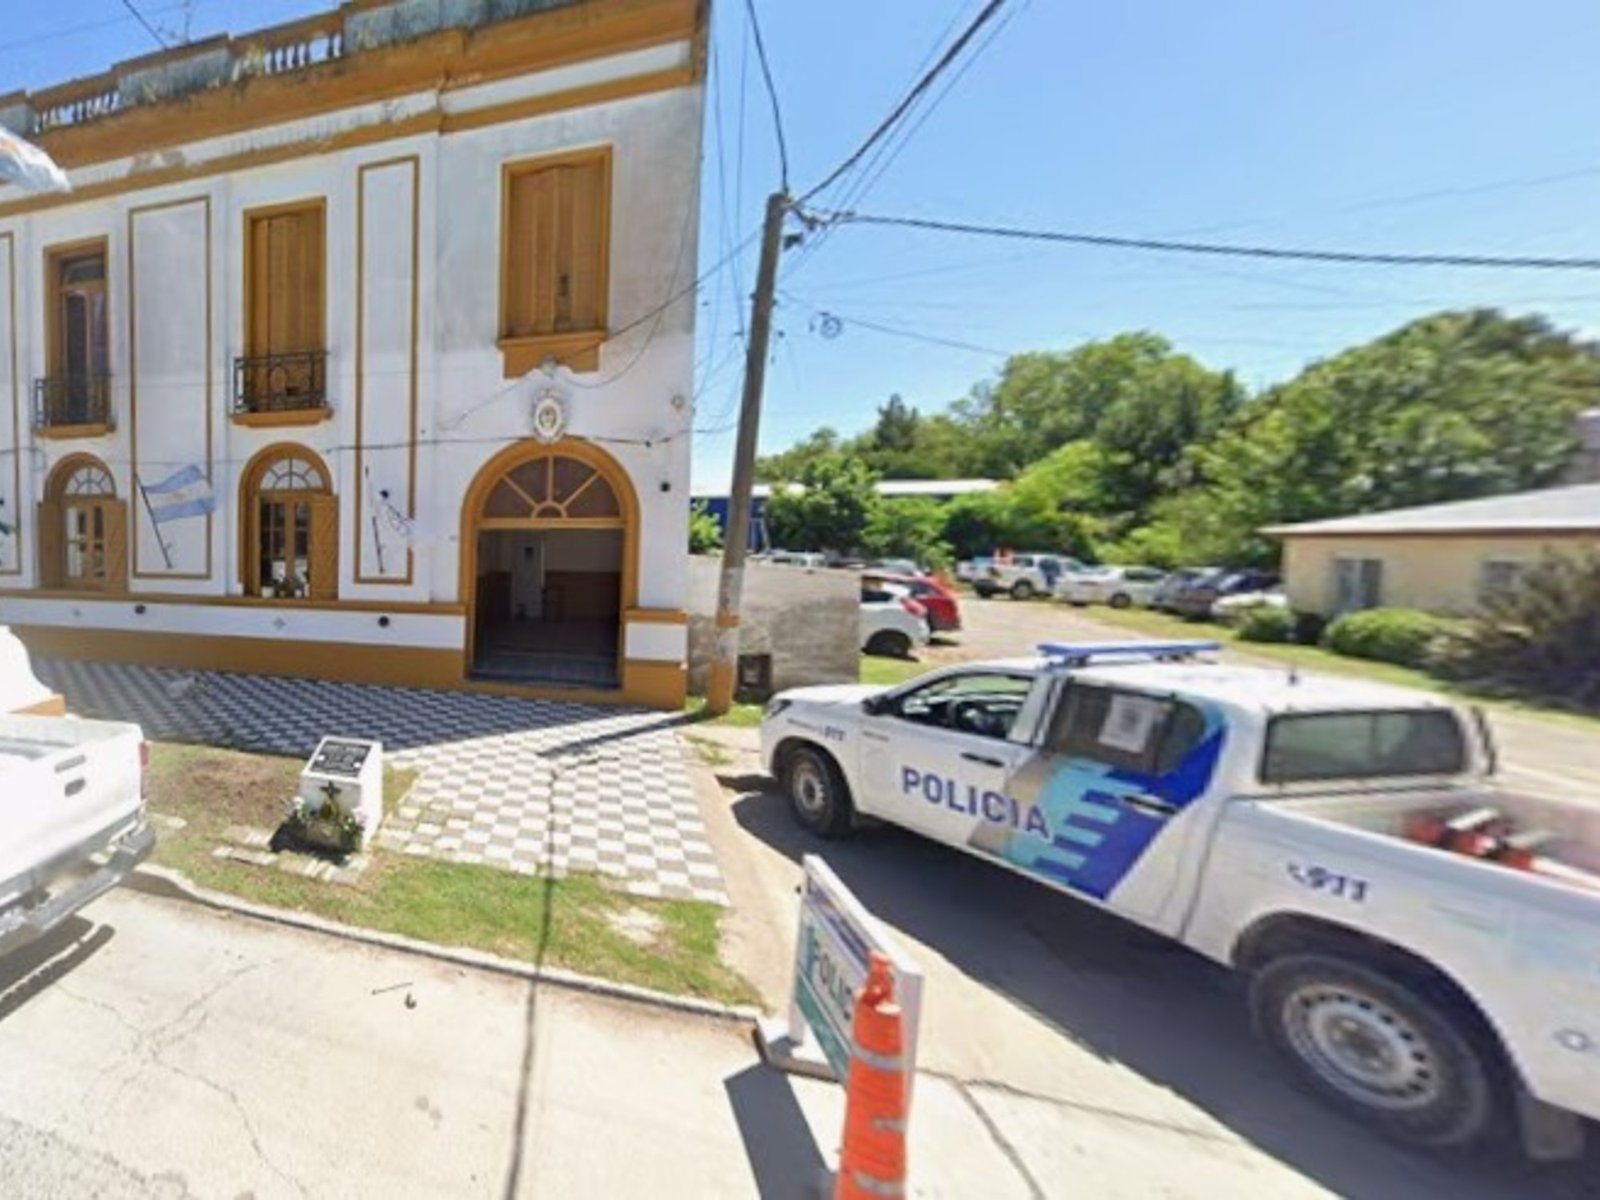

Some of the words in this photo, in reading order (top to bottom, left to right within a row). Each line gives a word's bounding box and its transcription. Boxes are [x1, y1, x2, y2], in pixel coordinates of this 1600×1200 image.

[902, 766, 1050, 839] POLICIA
[1307, 866, 1368, 901] 911
[805, 924, 853, 1021] POLIC
